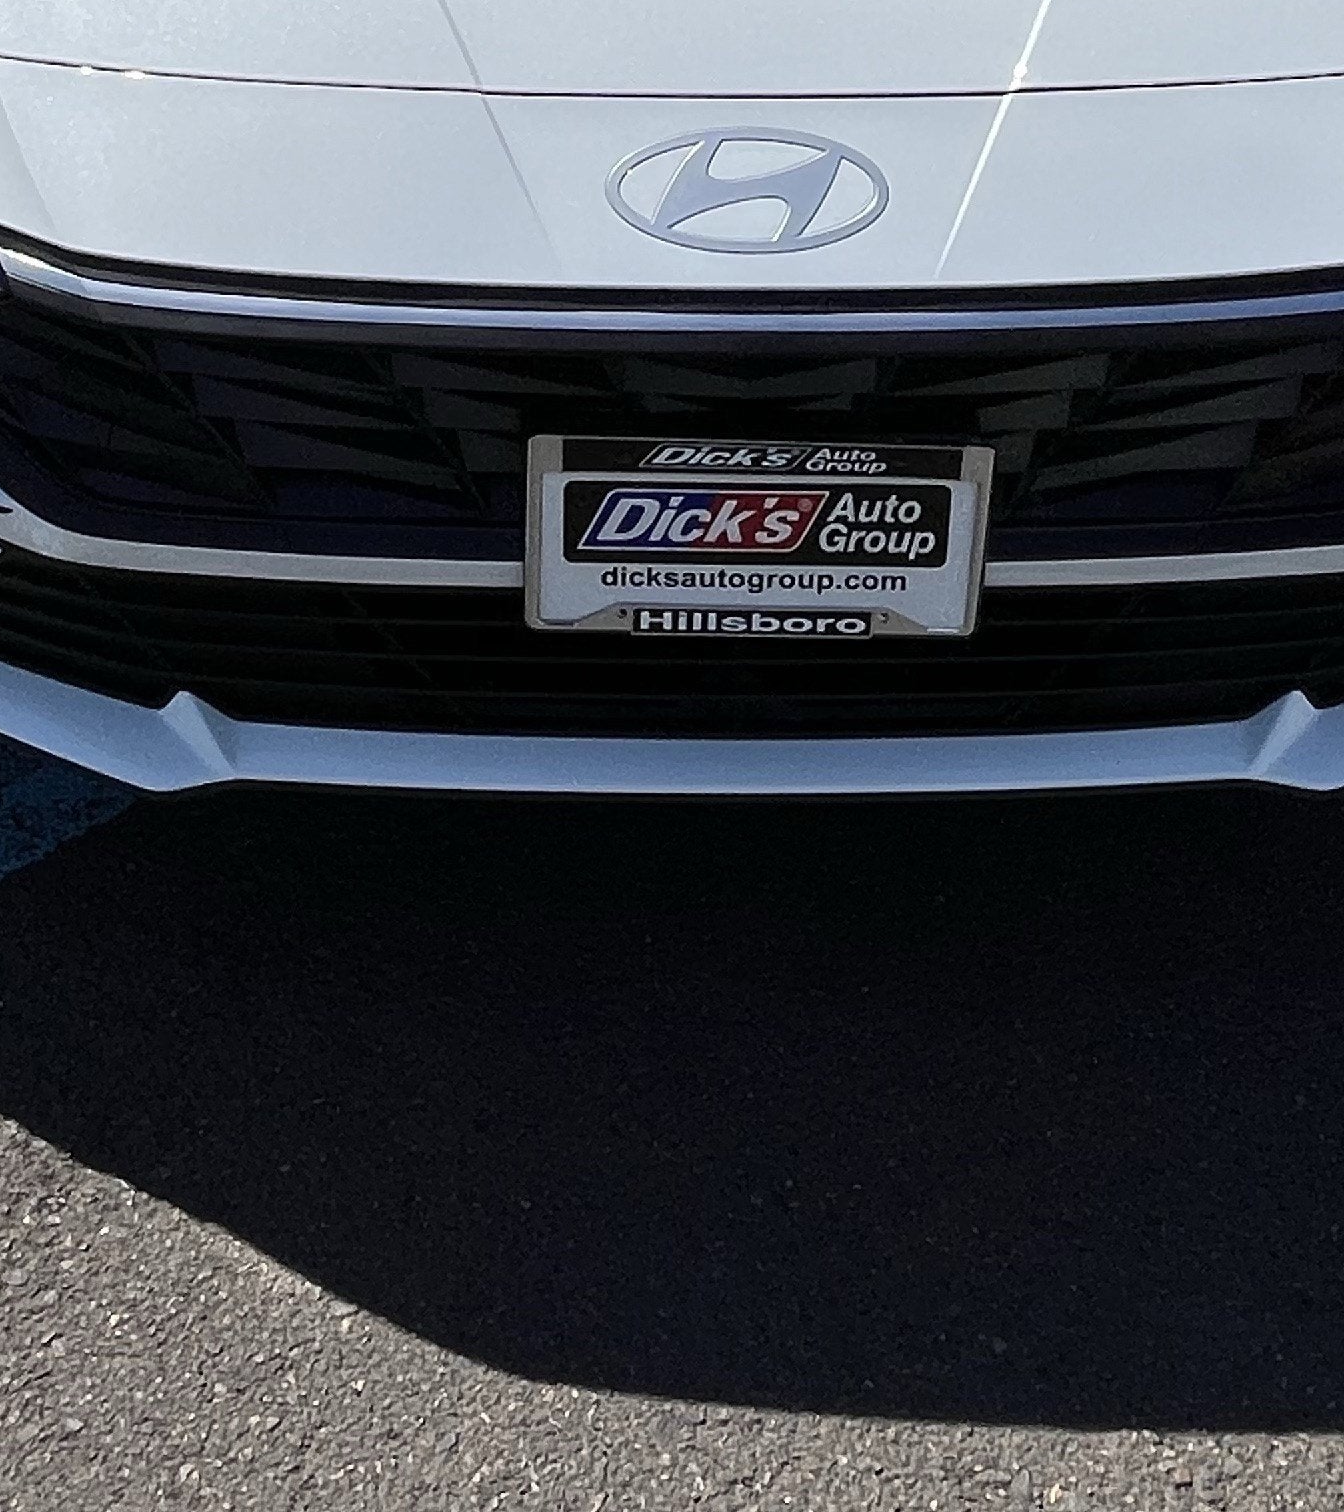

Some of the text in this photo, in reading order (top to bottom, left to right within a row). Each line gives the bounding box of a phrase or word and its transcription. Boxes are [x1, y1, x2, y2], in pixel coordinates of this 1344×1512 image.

[651, 446, 876, 468] Dick's Auto
[806, 459, 887, 474] Group
[596, 492, 922, 543] Dick's Auto
[819, 523, 936, 561] Group
[601, 566, 907, 594] dicksautogroup.com
[640, 610, 867, 634] Hillsboro
